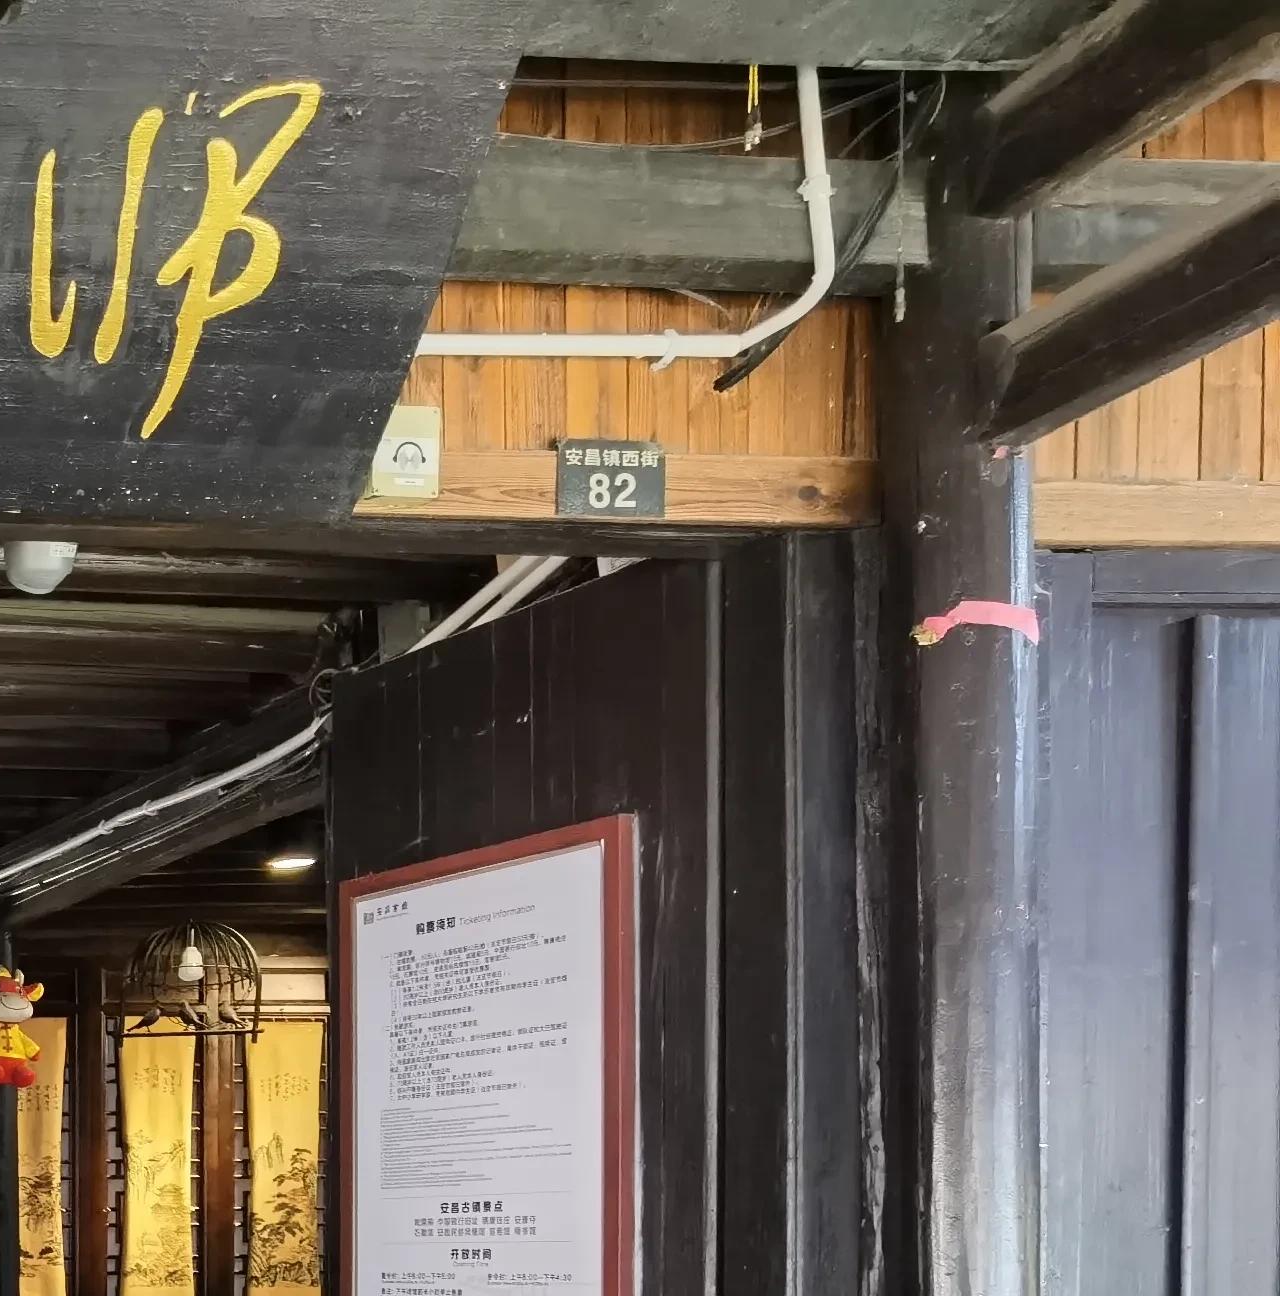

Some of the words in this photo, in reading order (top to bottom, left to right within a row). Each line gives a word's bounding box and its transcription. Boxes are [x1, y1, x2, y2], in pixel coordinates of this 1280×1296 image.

[565, 448, 659, 467] 安昌镇西街
[589, 473, 637, 508] 82
